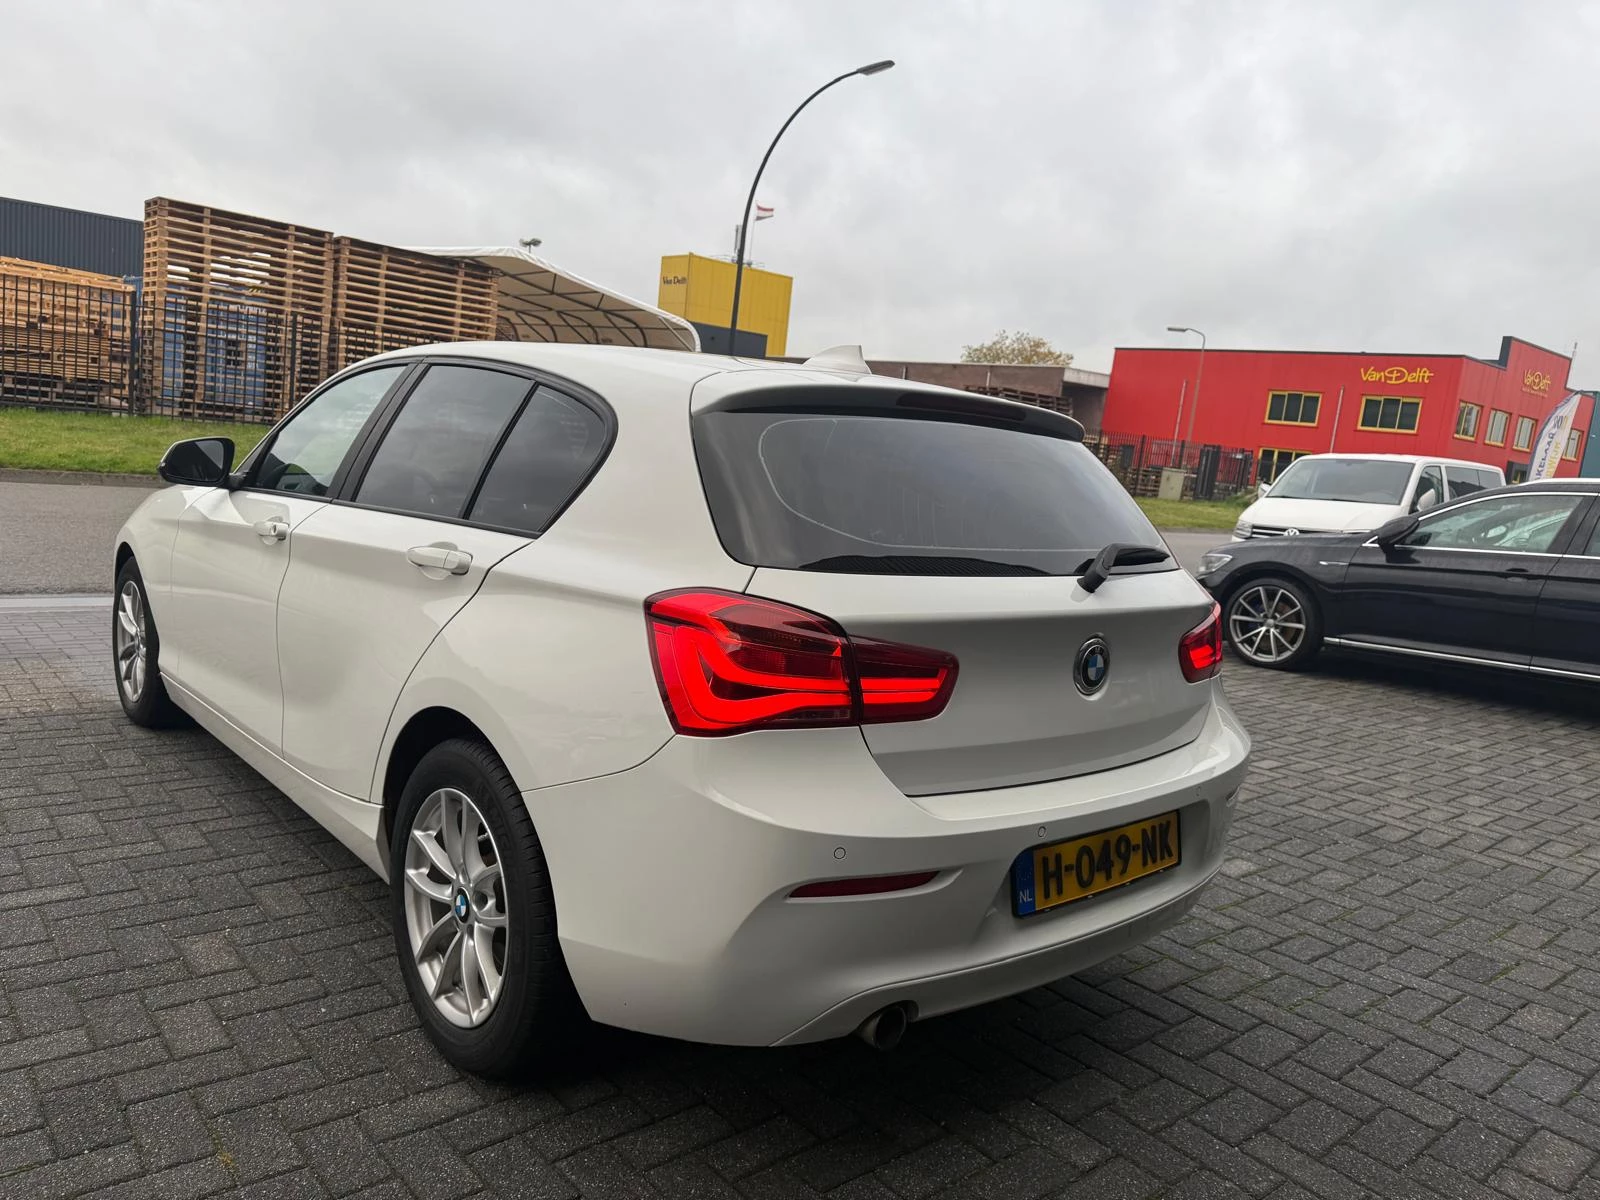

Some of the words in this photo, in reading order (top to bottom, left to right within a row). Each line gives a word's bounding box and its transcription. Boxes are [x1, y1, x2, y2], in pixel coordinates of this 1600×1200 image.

[1360, 366, 1385, 383] Van
[1385, 367, 1434, 384] Delft
[1042, 820, 1174, 899] H-049-NK
[1019, 888, 1033, 903] NL
